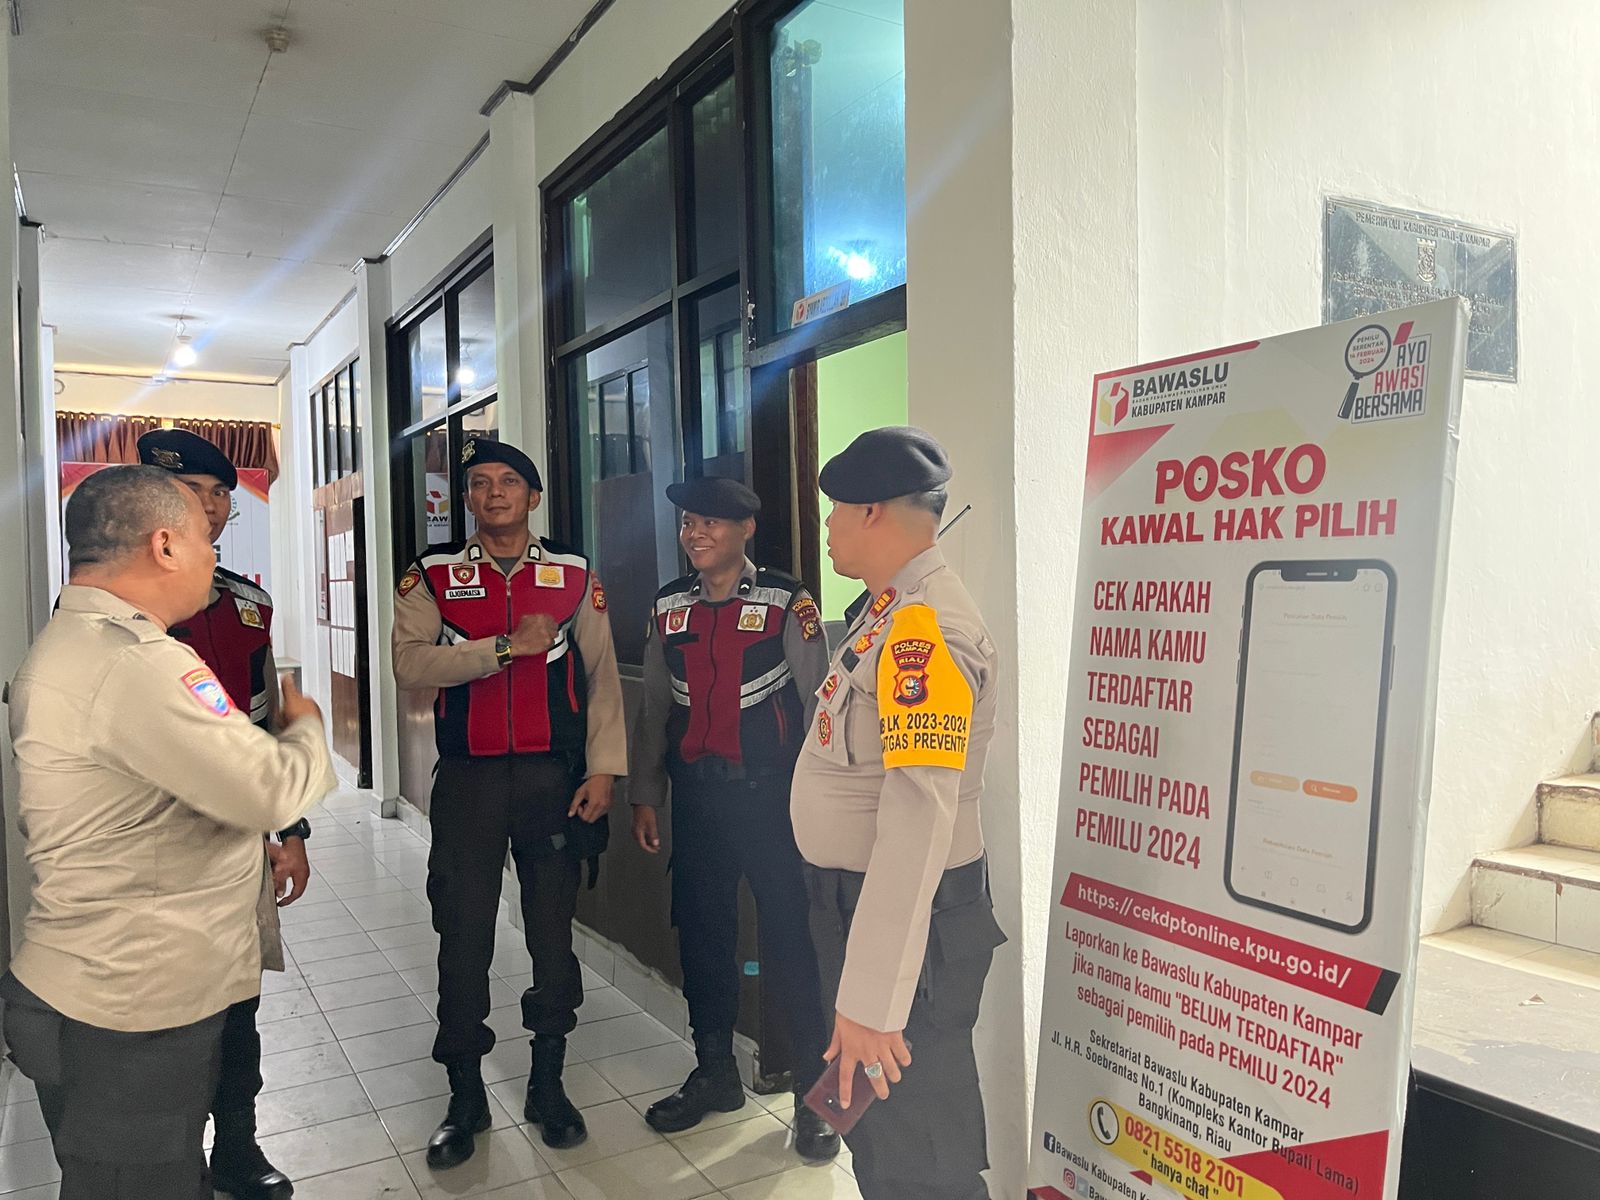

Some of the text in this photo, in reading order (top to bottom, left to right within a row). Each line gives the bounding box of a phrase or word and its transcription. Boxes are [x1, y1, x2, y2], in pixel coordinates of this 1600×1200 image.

[1352, 341, 1384, 352] SERENTAK
[1356, 333, 1380, 343] PEMILU
[1356, 348, 1386, 358] FEBRUARI
[1396, 340, 1427, 368] AYO
[1132, 362, 1229, 398] BAWASLU
[1374, 364, 1424, 394] AWASI
[1132, 391, 1226, 418] KABUPATEN KAMPAR
[1354, 389, 1424, 420] BERSAMA
[1154, 443, 1326, 504] POSKO
[1100, 498, 1398, 546] KAWAL HAK PILIH
[1094, 580, 1212, 614] CEK APAKAH
[894, 641, 932, 650] POLRES
[1090, 626, 1206, 664] NAMA KAMU
[1087, 671, 1193, 714] TERDAFTAR
[887, 714, 900, 732] LK
[906, 712, 966, 734] 2023-2024
[1082, 716, 1160, 758] SEBAGAI
[1079, 762, 1153, 807] PEMILIH
[1158, 777, 1210, 820] PADA
[1076, 808, 1201, 870] PEMILU 2024
[1078, 883, 1352, 989] https://cekdptonline.kpu.go.id/
[1065, 921, 1363, 1050] Laporkan ke Bawaslu Kabupaten Kampar
[1072, 952, 1344, 1076] jika nama kamu "BELUM TERDAFTAR"
[1077, 986, 1332, 1109] sebagai pemilih pada PEMILU 2024
[1090, 1029, 1304, 1144] Sekretariat Bawaslu Kabupaten Kampar
[1051, 1030, 1360, 1196] Jl. H.R. Soebrantas No.1 (Kompleks Kantor Bupati Lama)
[1138, 1092, 1232, 1152] Bangkinang, Riau
[1056, 1141, 1089, 1172] Bawaslu
[1091, 1162, 1137, 1200] Kabupaten
[1124, 1116, 1244, 1198] 0821 5518 2101
[1150, 1154, 1182, 1184] hanya
[1185, 1176, 1210, 1200] chat
